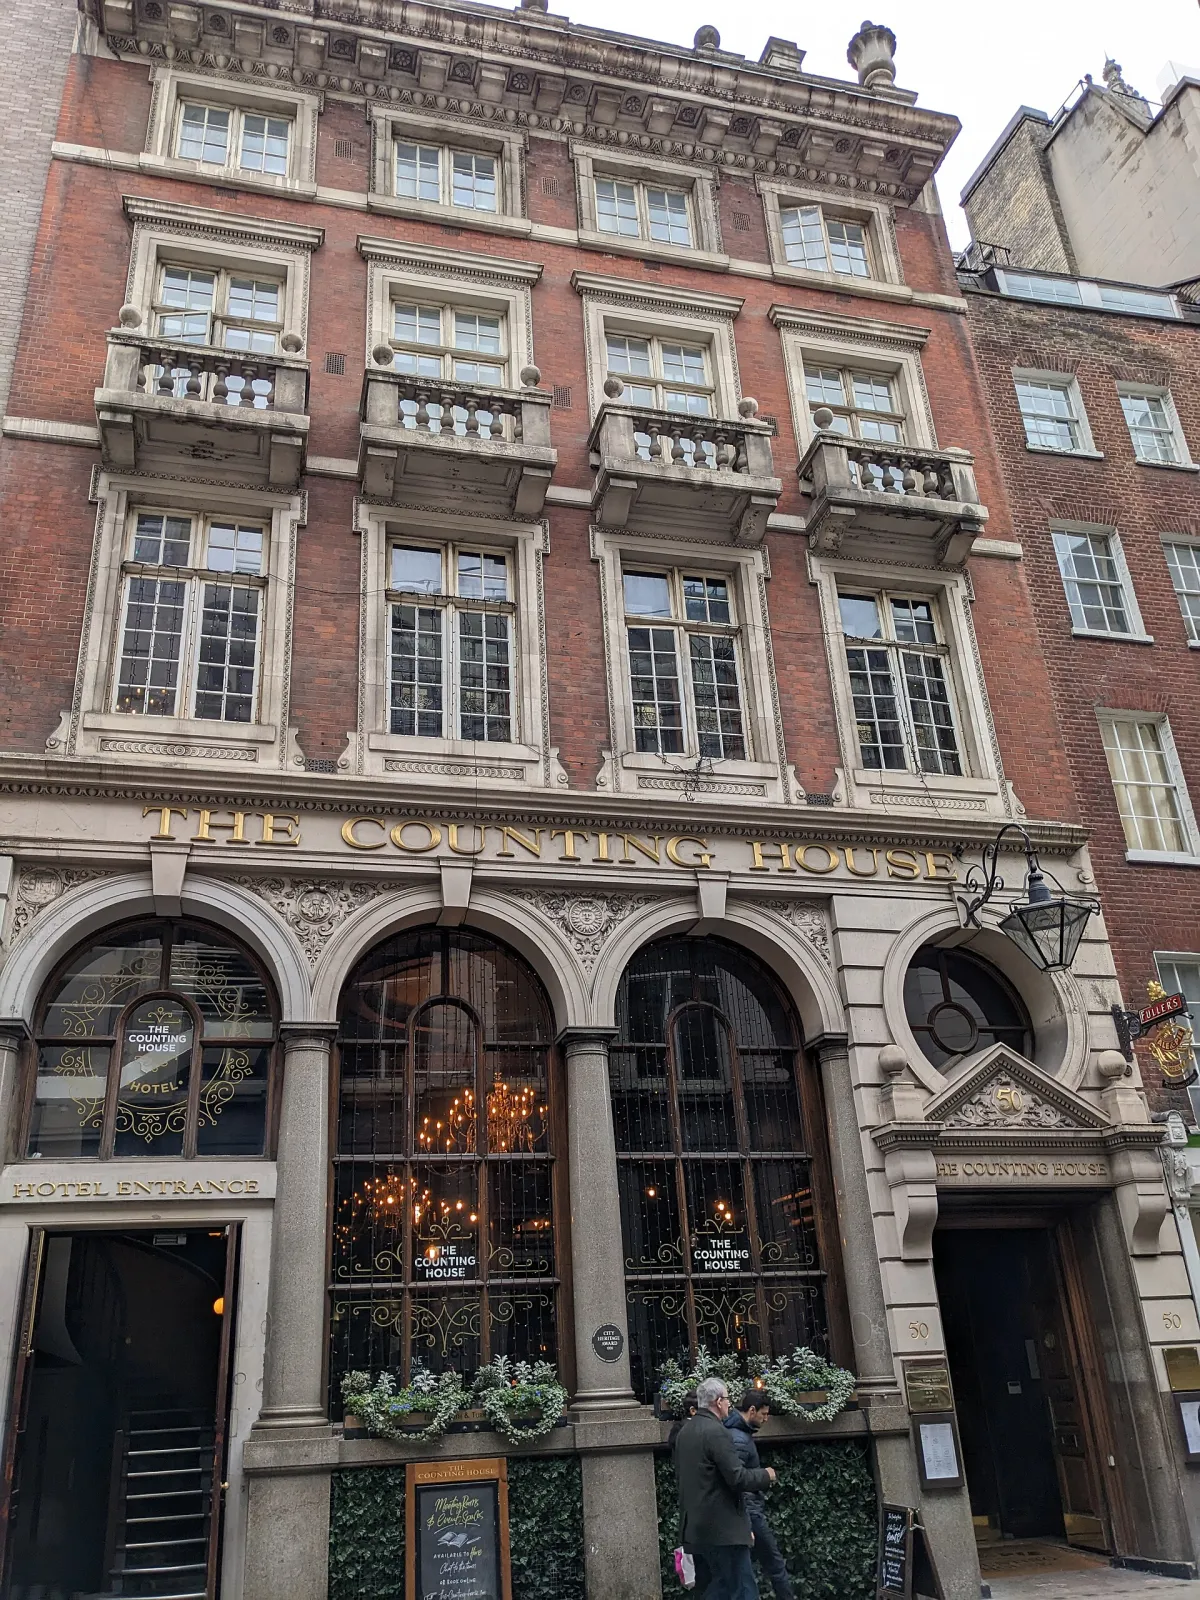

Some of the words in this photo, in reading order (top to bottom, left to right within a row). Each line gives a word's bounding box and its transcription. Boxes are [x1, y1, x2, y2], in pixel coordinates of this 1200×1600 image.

[142, 806, 300, 846] THE
[341, 816, 716, 869] COUNTING
[746, 840, 958, 881] HOUSE
[1140, 998, 1179, 1020] FULLER'S
[148, 1025, 170, 1034] THE
[128, 1034, 187, 1043] COUNTING
[138, 1043, 176, 1052] HOUSE
[130, 1081, 179, 1094] HOTEL
[997, 1088, 1022, 1110] 50
[936, 1163, 959, 1177] HE
[962, 1162, 1049, 1176] COUNTING
[1052, 1162, 1108, 1176] HOUSE
[13, 1182, 109, 1198] HOTEL
[116, 1179, 260, 1196] ENTRANCE
[710, 1239, 731, 1248] THE
[694, 1249, 749, 1259] COUNTING
[414, 1256, 476, 1267] COUNTING
[704, 1260, 741, 1270] HOUSE
[425, 1267, 466, 1278] HOUSE
[1162, 1312, 1182, 1329] 50
[908, 1321, 929, 1338] 50
[418, 1470, 464, 1479] COUNTING
[466, 1468, 496, 1476] HOUSE
